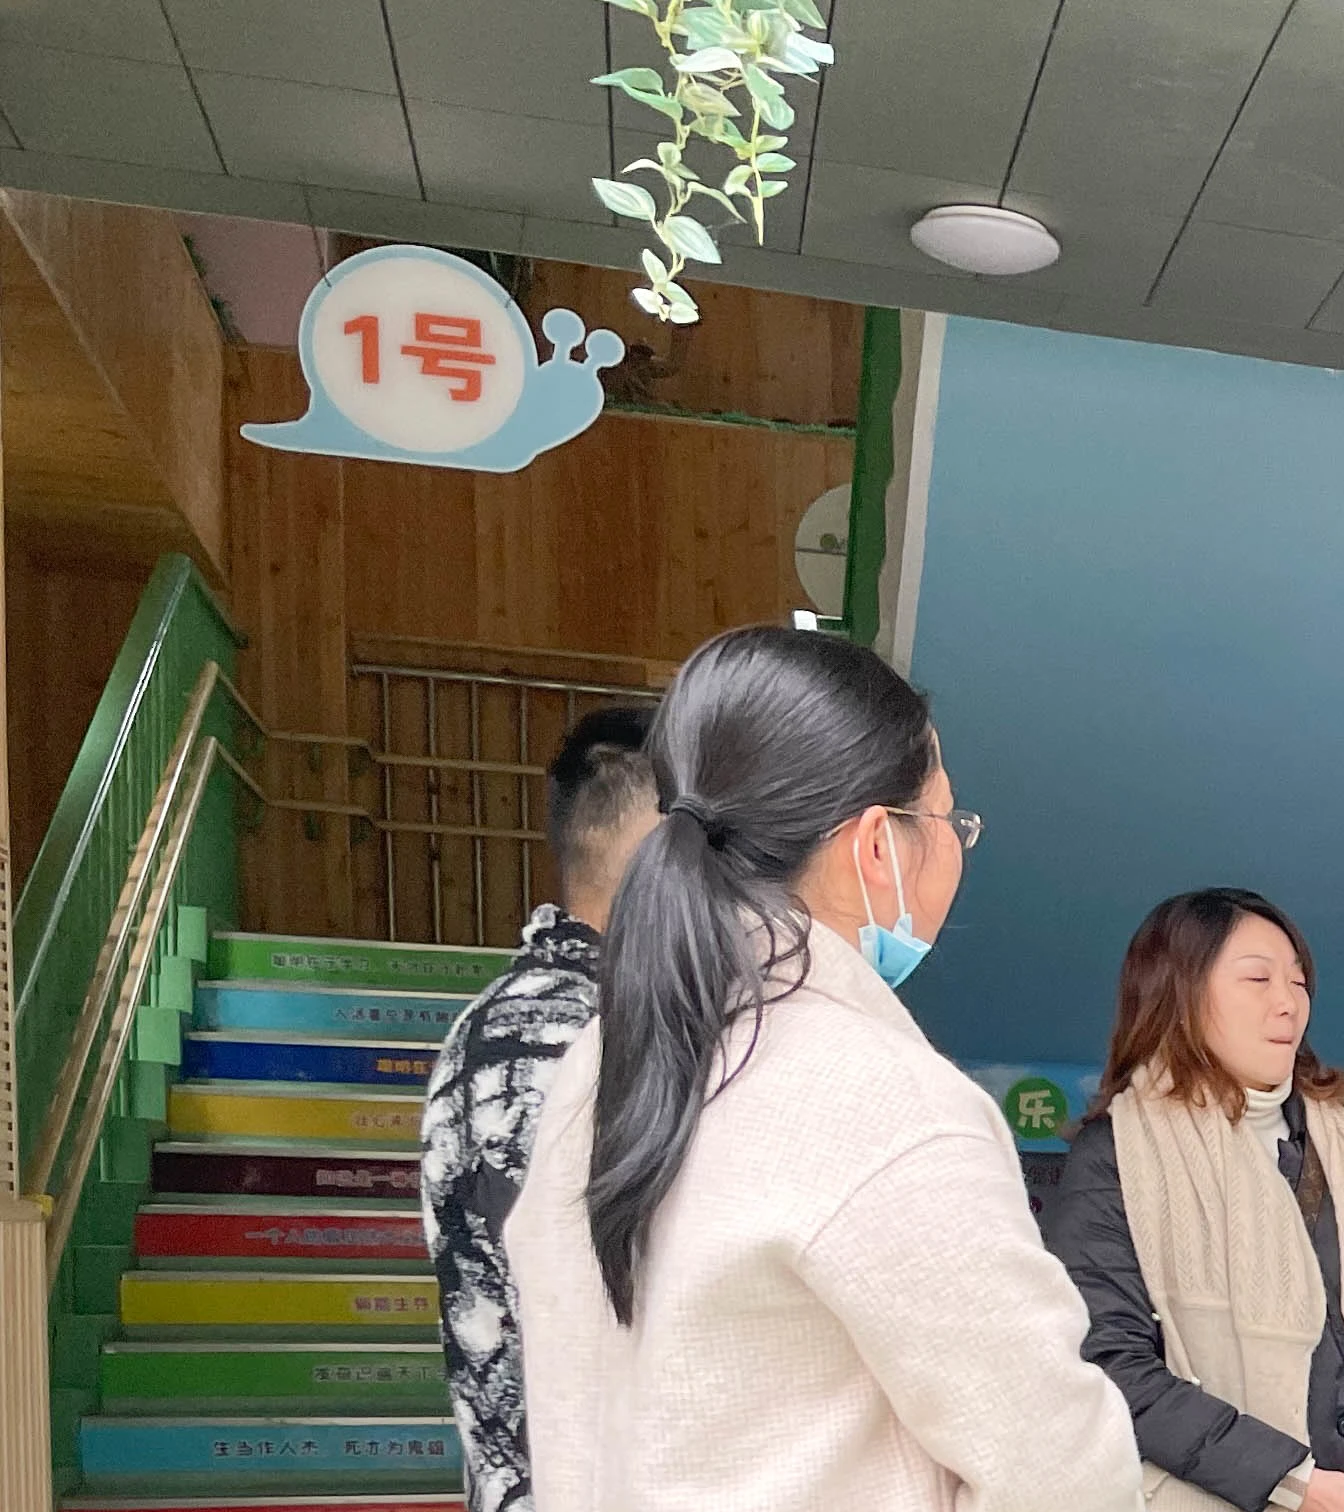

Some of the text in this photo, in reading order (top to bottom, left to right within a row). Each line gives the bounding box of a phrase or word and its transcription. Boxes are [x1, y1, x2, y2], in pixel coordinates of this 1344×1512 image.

[344, 312, 496, 402] 1号
[1018, 1090, 1055, 1128] 乐
[214, 1440, 319, 1458] 生当作人杰
